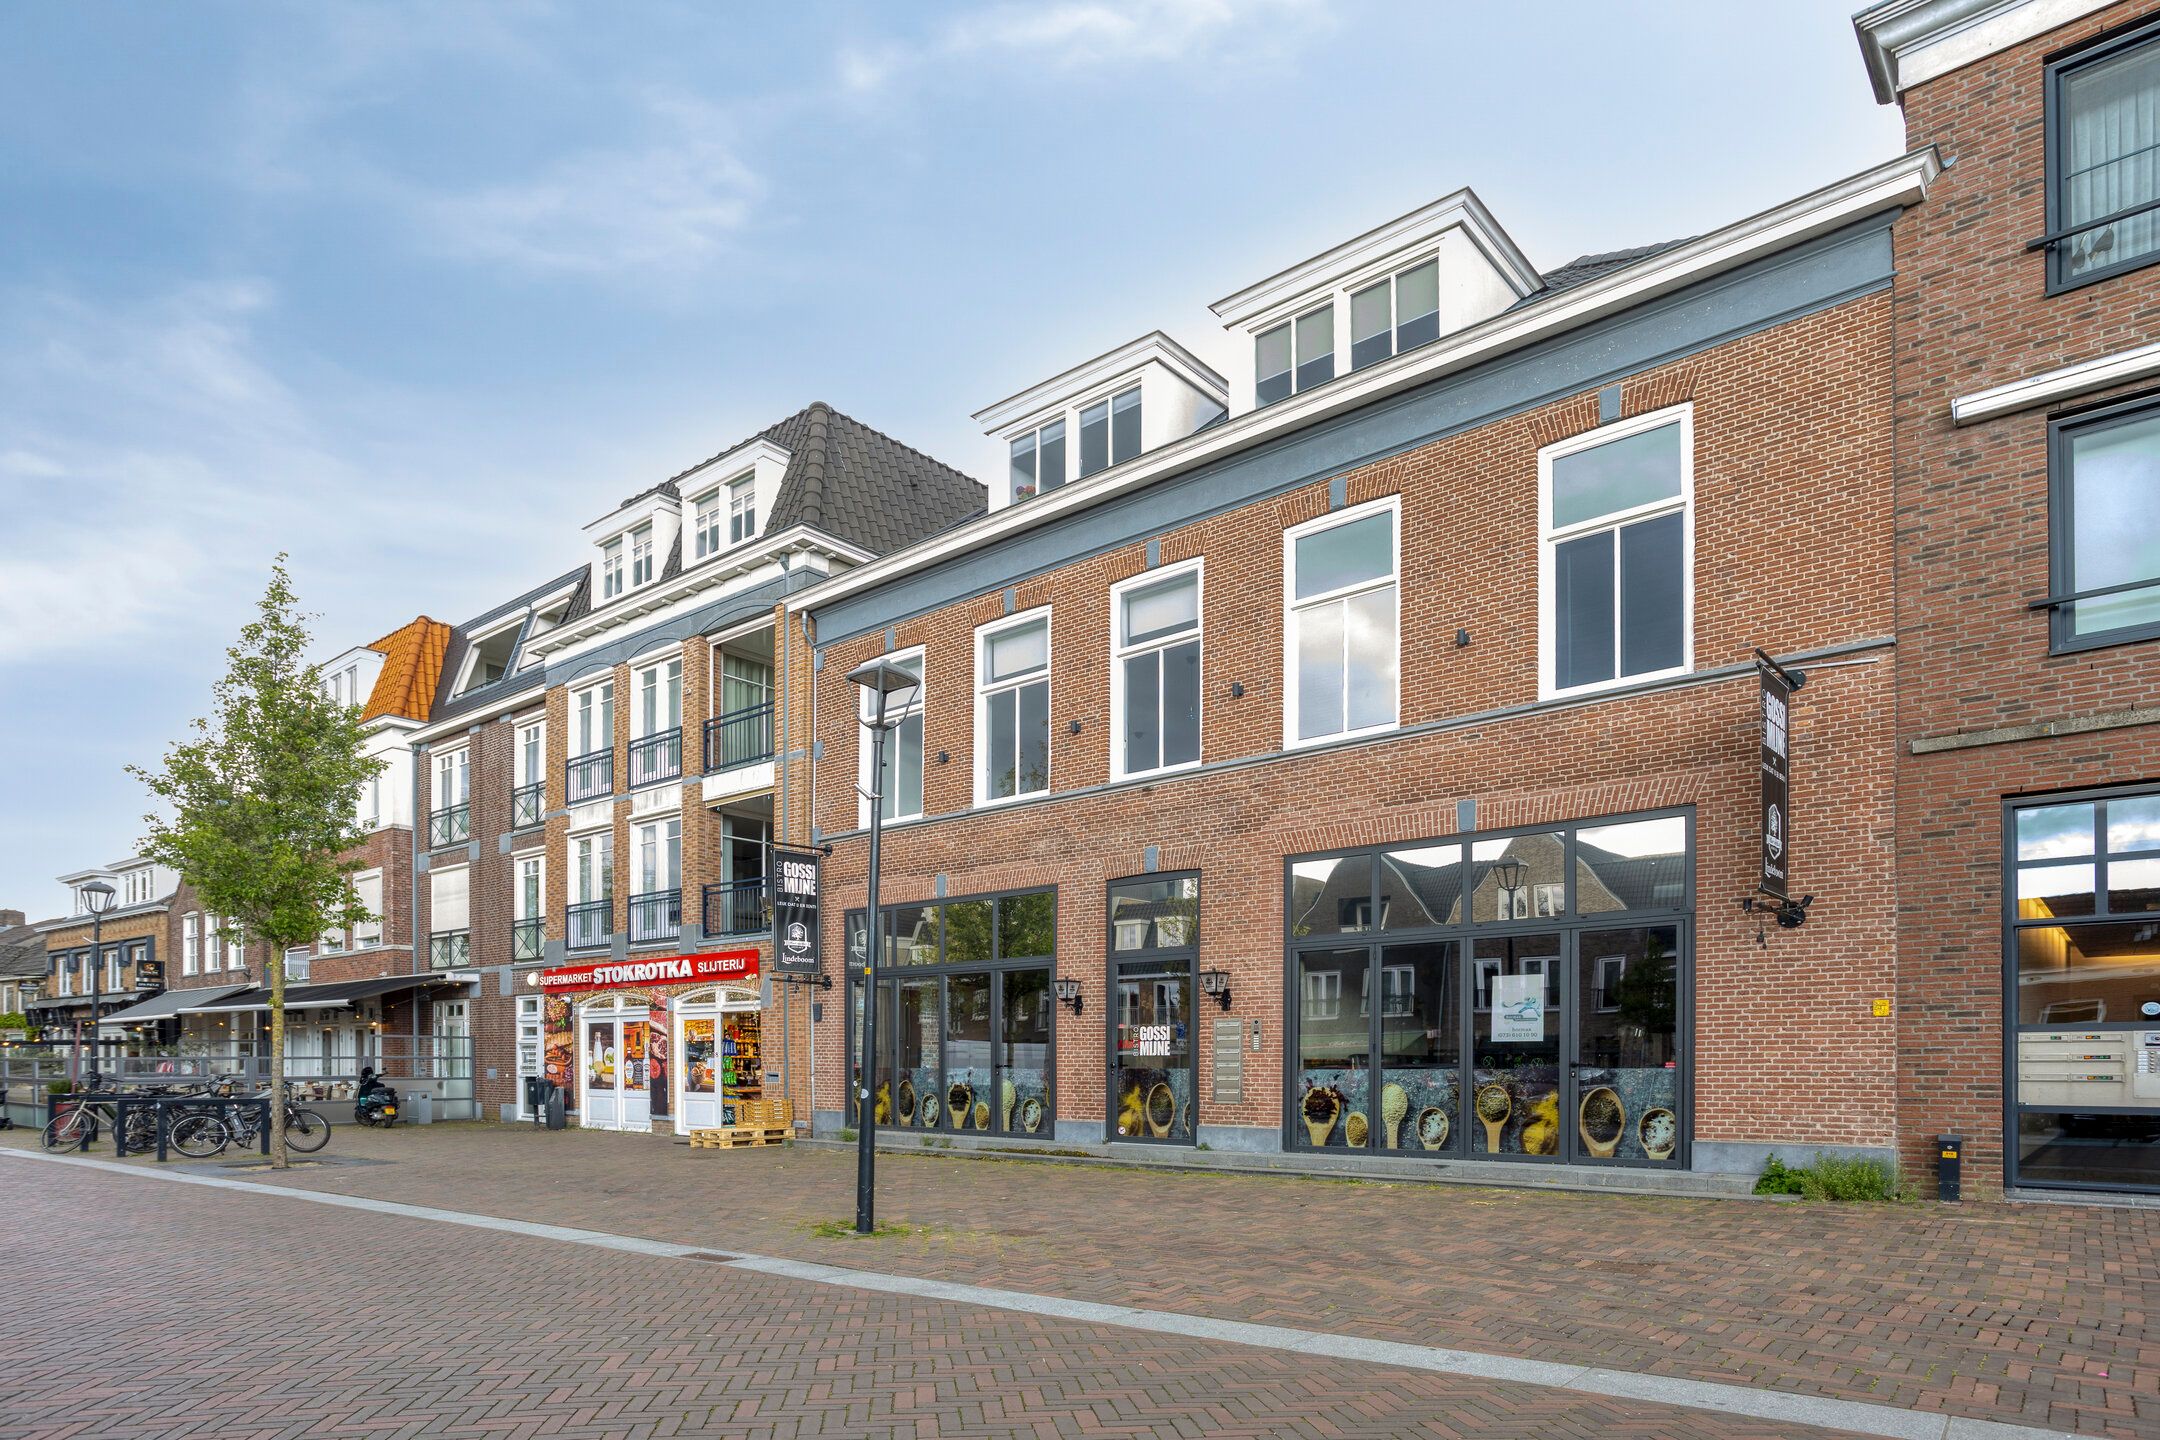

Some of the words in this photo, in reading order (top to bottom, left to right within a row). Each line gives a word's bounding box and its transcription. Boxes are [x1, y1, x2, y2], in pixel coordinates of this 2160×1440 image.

[783, 861, 816, 880] GOSSI
[781, 952, 815, 965] Lindeboom
[540, 972, 592, 986] SUPERMARKET
[593, 959, 694, 985] STOKROTKA
[697, 958, 745, 974] SLIJTERIJ
[1139, 1025, 1171, 1041] GOSSI
